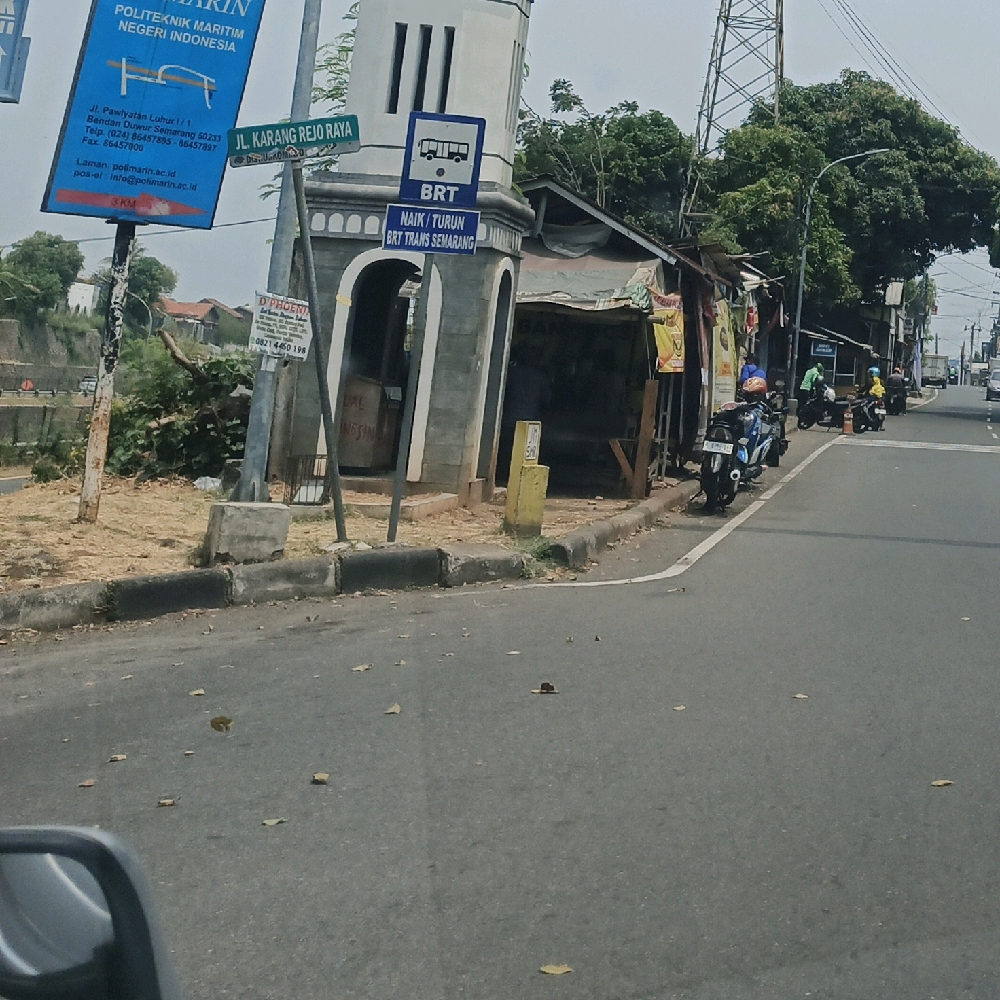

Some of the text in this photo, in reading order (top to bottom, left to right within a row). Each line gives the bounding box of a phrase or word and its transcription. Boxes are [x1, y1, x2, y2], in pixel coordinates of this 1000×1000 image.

[114, 4, 245, 39] POLITEKNIK MARITIM
[118, 20, 236, 53] NEGERI INDONESIA
[89, 105, 100, 114] Jl.
[102, 106, 148, 121] Pawiyatan
[149, 113, 174, 125] Luhur
[86, 114, 122, 127] Bendan
[123, 120, 152, 132] Duwur
[153, 125, 196, 140] Semarang
[107, 129, 130, 140] (024)
[235, 120, 353, 151] JL. KARANG REJO RAYA
[112, 162, 176, 178] polimarin.ac.id
[110, 174, 198, 192] info@polimarin.ac.id
[420, 183, 460, 203] BRT
[110, 197, 137, 210] 3 KM
[400, 210, 465, 231] NAIK / TURUN
[386, 230, 475, 250] BRT TRANS SEMARANG
